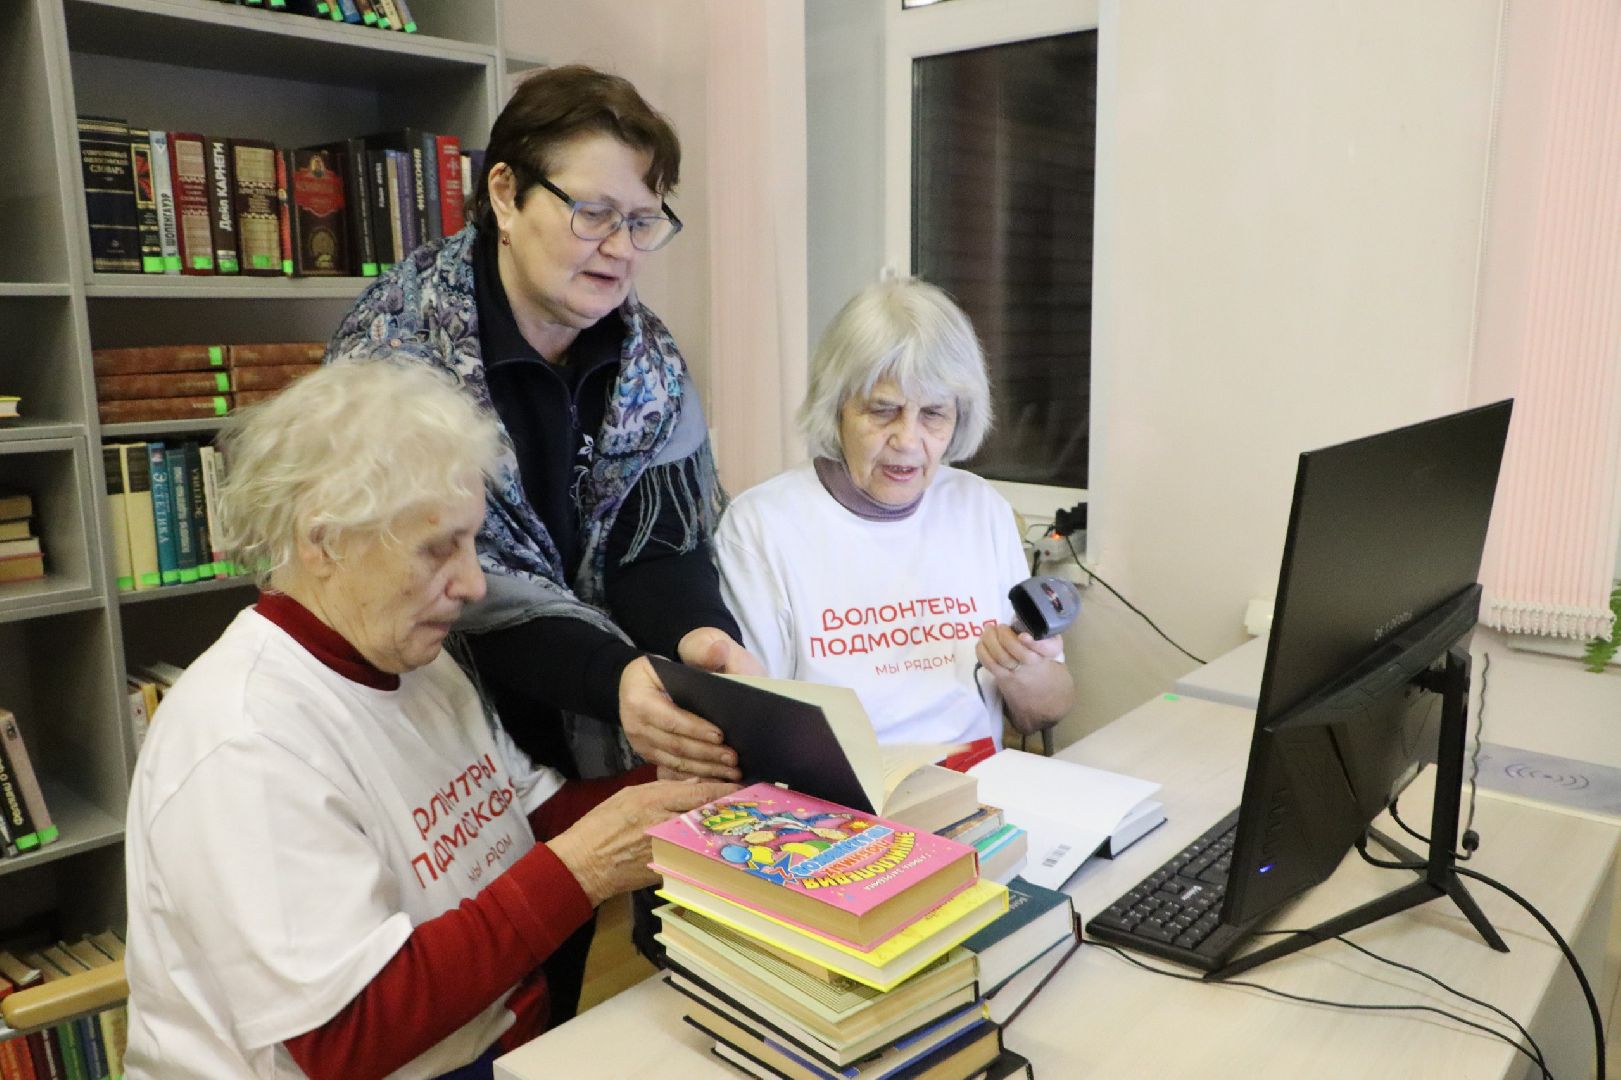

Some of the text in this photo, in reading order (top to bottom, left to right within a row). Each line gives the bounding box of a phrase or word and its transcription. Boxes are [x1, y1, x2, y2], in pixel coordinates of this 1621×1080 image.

[212, 142, 233, 232] Дейл КАРНЕГИ
[160, 193, 176, 247] ШОПЕНГАУЭР
[152, 471, 169, 543] ЭСТЕТИКА
[822, 596, 977, 631] ВОЛОНТЕРЫ
[875, 654, 956, 676] МЫ РЯДОМ
[801, 831, 915, 890] ЭНЦИКЛОПЕДИЯ
[823, 839, 893, 877] ЛЮБИМЫХ
